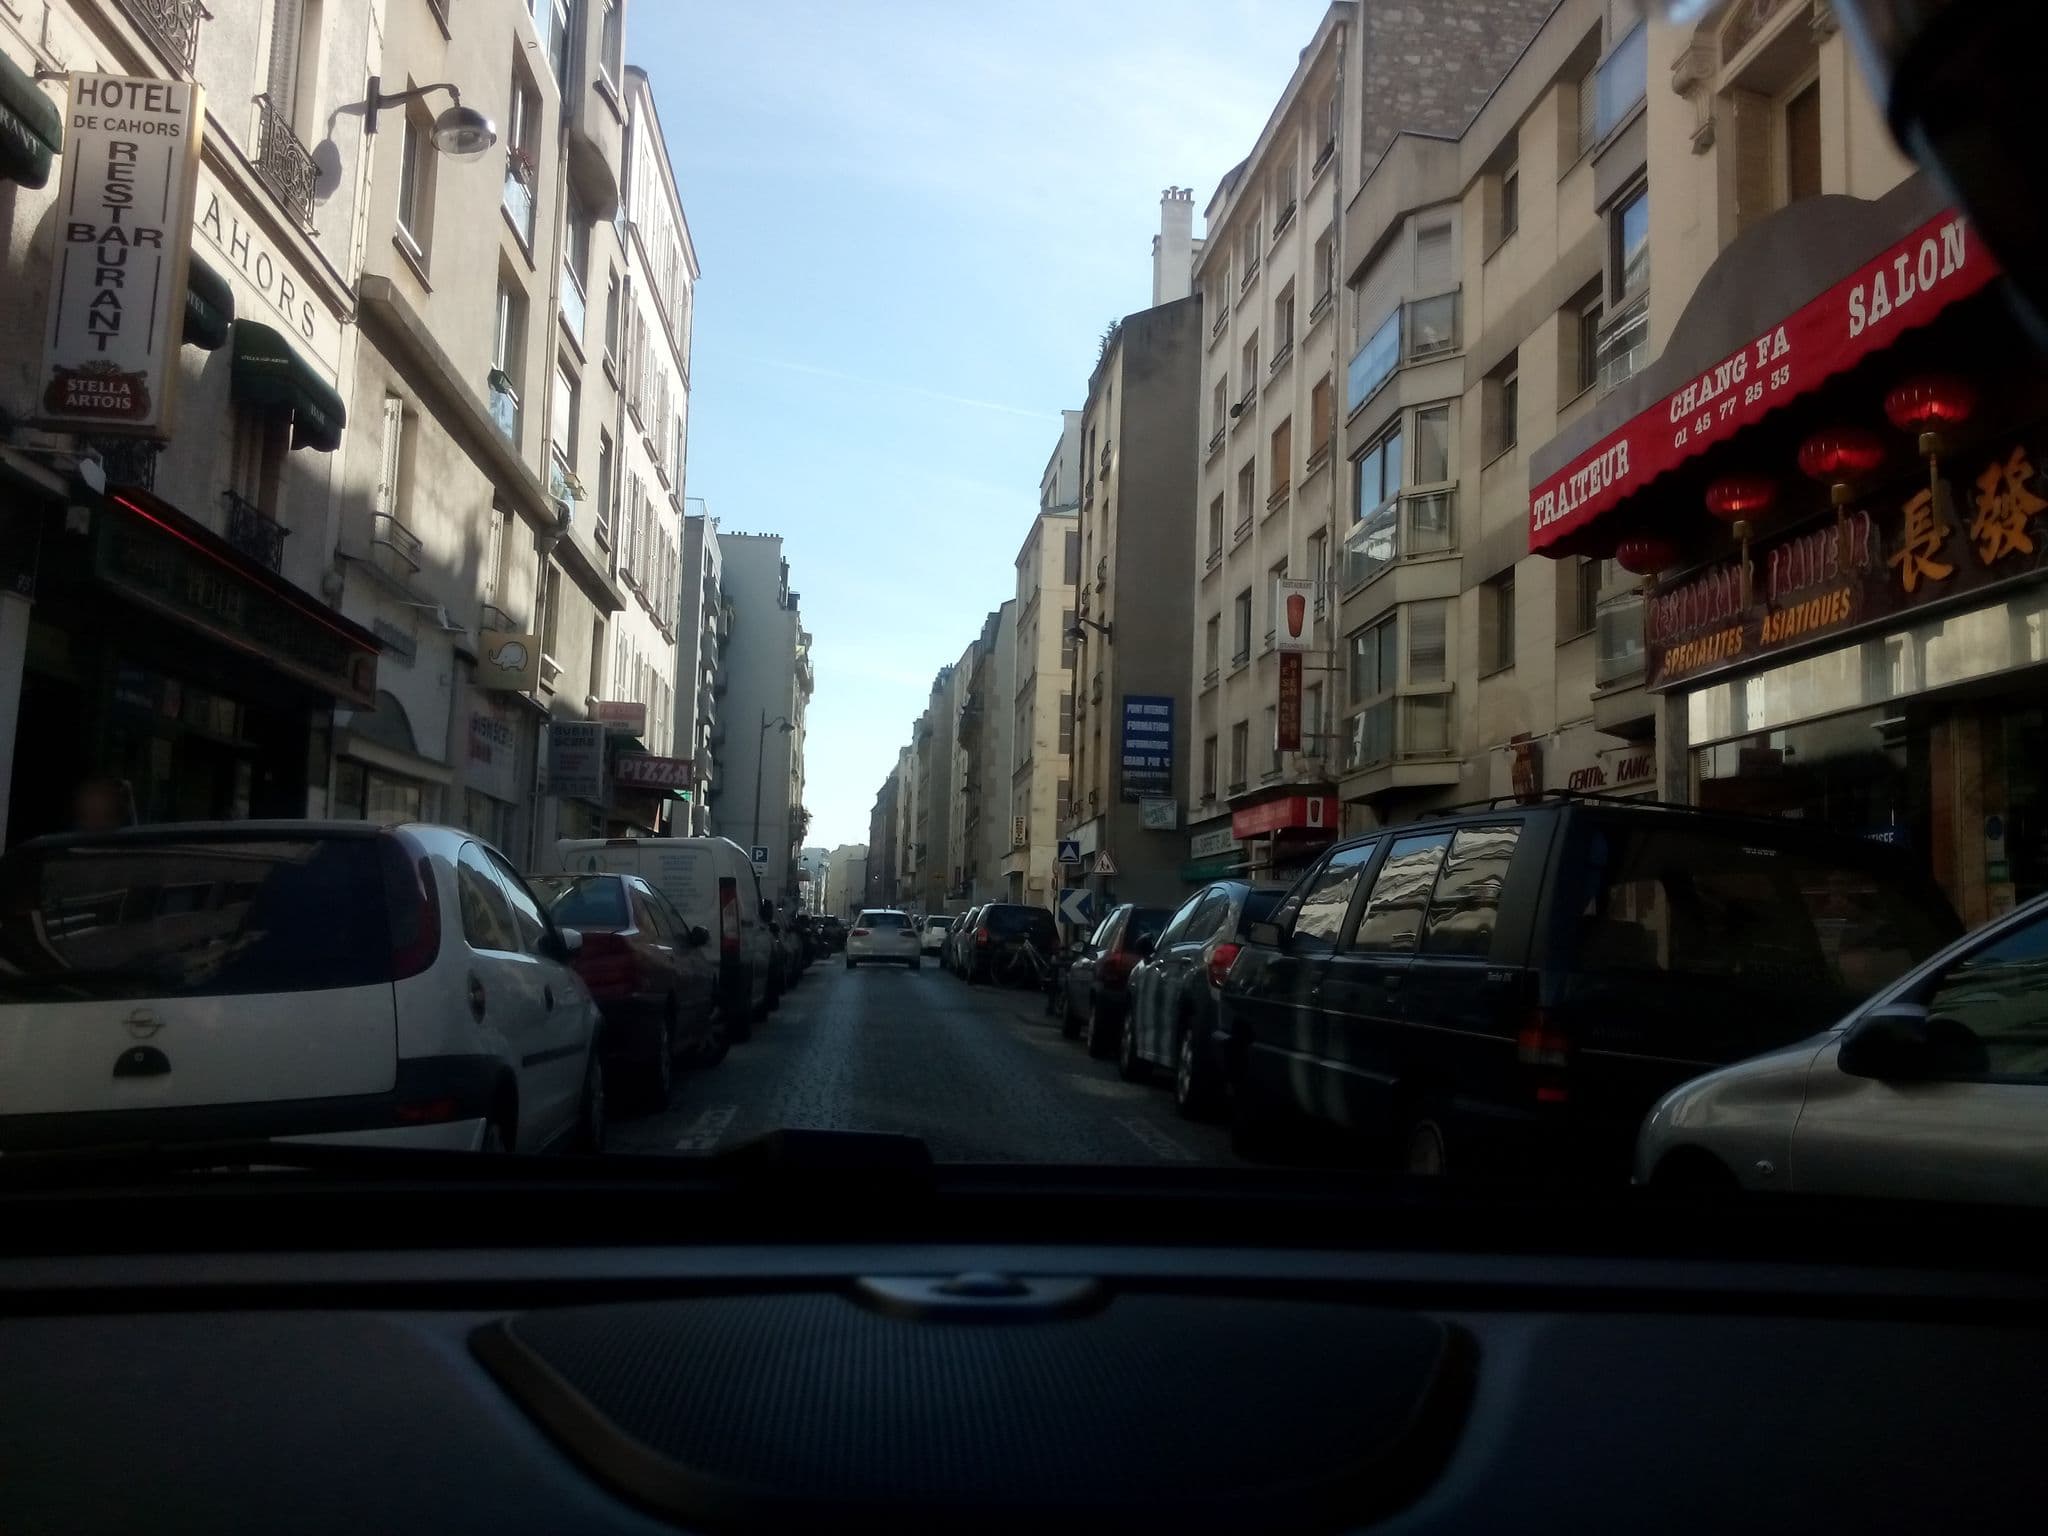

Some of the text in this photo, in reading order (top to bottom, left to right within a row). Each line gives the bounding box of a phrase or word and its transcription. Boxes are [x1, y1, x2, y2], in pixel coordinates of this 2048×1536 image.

[73, 115, 180, 138] DE CAHORS
[76, 78, 182, 115] HOTEL
[66, 222, 165, 249] BAR
[87, 140, 139, 352] RESTAURANT
[203, 192, 316, 338] AHORS
[1848, 221, 1968, 339] SALON
[65, 393, 132, 410] ARTOIS
[67, 379, 131, 395] STELLA
[1669, 325, 1790, 424] CHANG FA
[1674, 363, 1790, 449] 01 45 77 25 33
[1533, 439, 1630, 532] TRAITEUR
[1663, 587, 1851, 678] SPECIALITES ASIATIQUES
[617, 759, 689, 785] PIZZA
[755, 849, 764, 861] P
